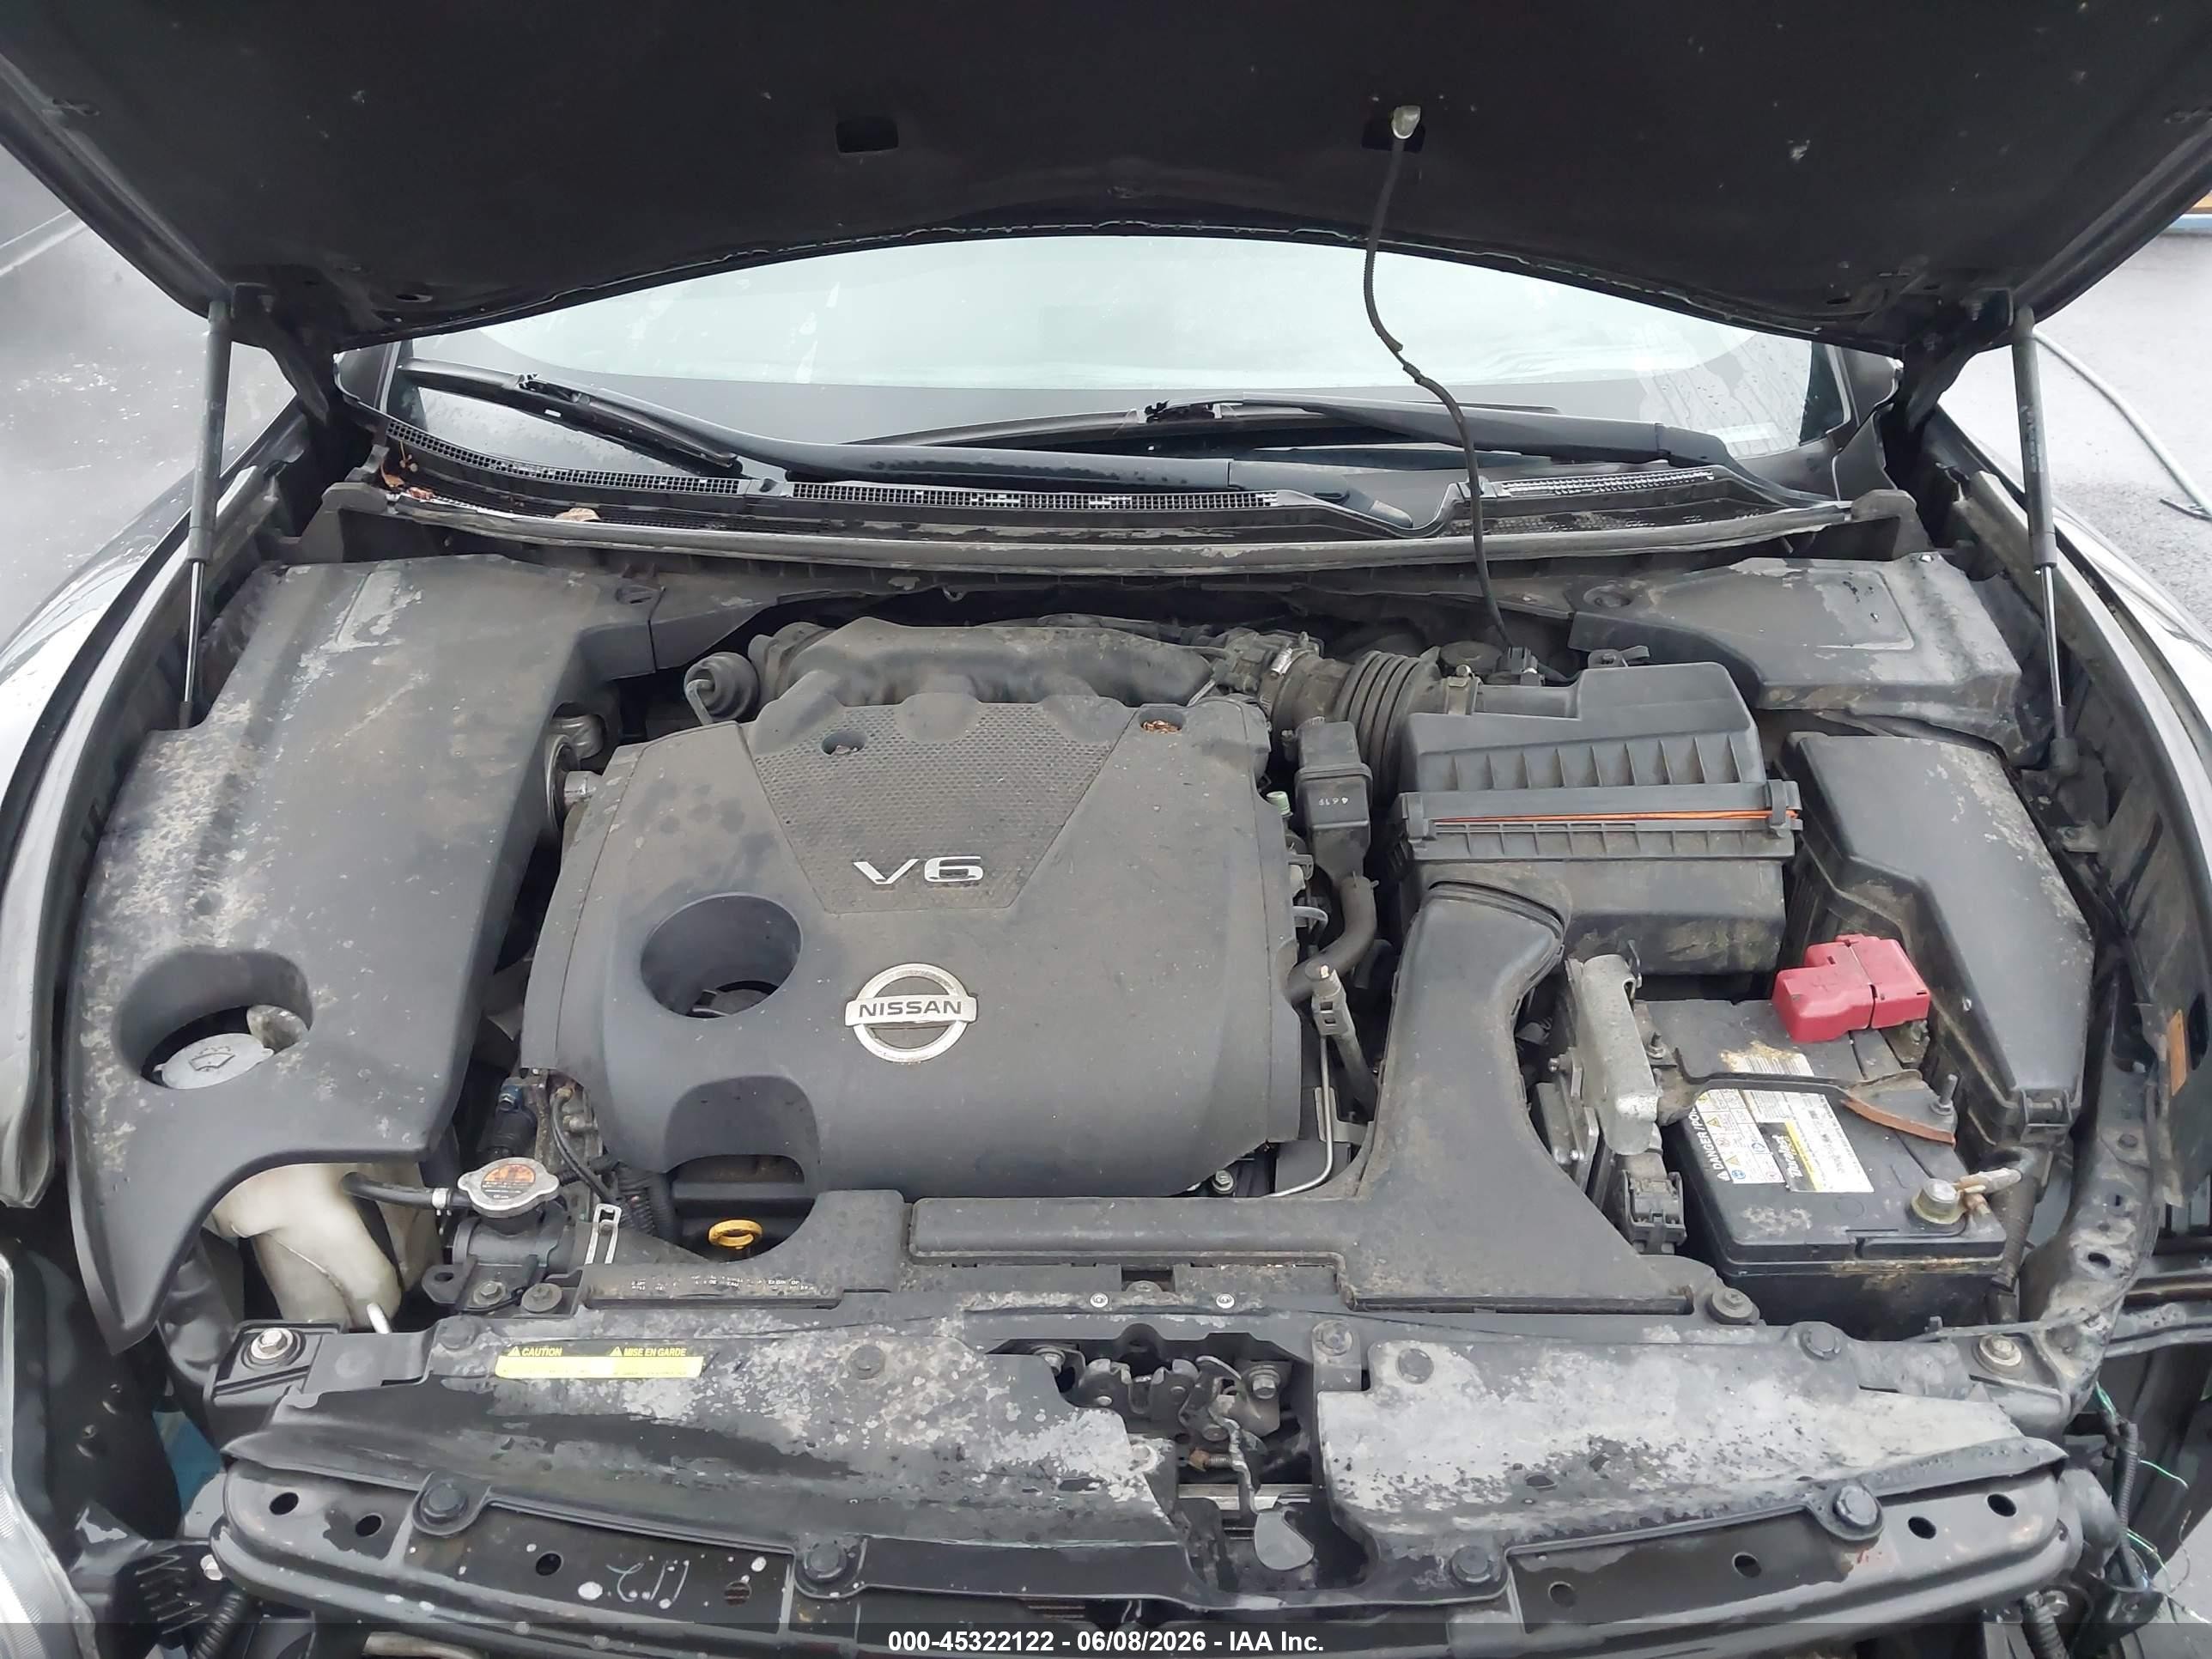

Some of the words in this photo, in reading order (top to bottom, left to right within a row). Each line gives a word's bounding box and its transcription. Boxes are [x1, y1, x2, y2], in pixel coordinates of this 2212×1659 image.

[853, 854, 984, 885] V6
[858, 1000, 963, 1018] NISSAN
[1697, 1131, 1725, 1170] DANGER
[521, 1347, 563, 1358] CAUTION
[623, 1347, 643, 1358] MISE
[644, 1347, 657, 1358] EN
[658, 1347, 687, 1358] GARDE
